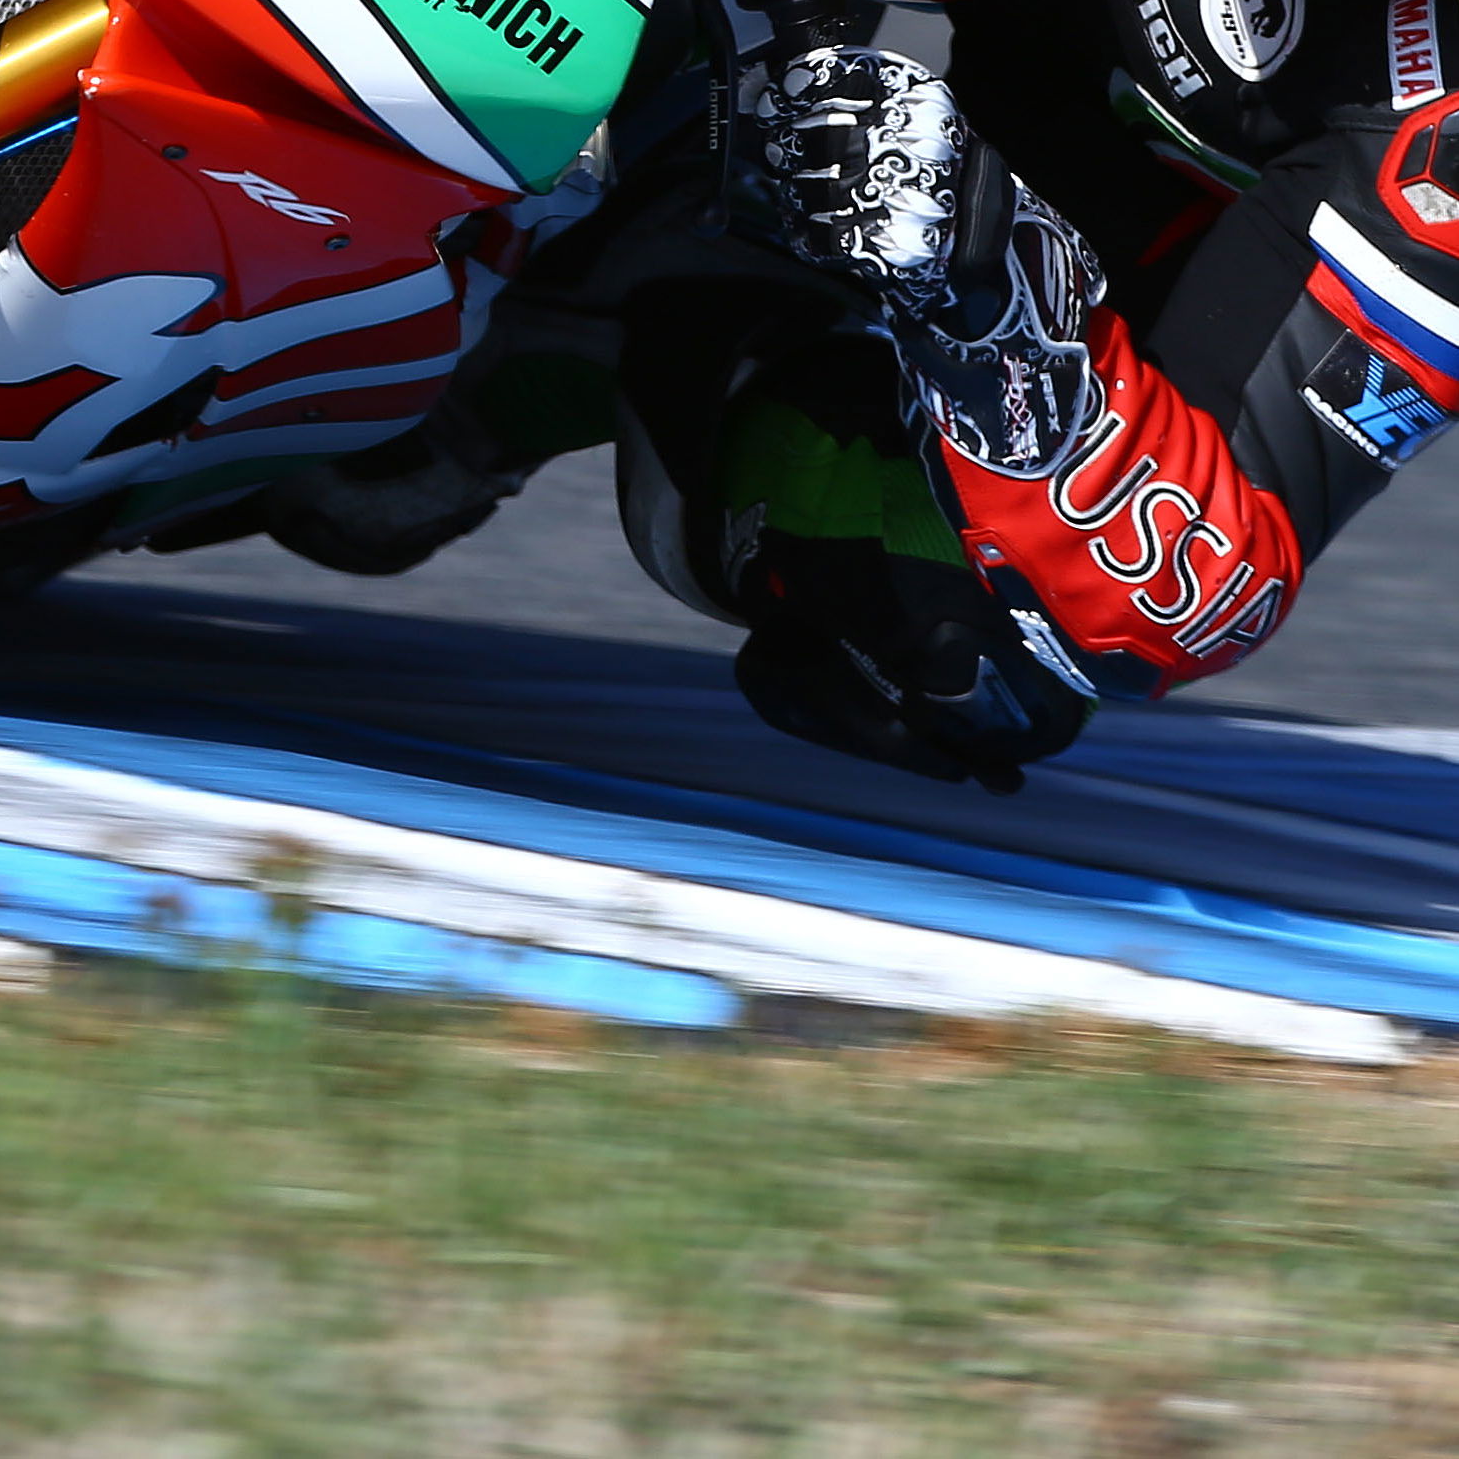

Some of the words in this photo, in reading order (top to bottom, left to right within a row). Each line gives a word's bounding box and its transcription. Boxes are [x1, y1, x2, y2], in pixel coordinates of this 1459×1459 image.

[709, 78, 730, 151] domino
[197, 167, 352, 227] R6
[1049, 373, 1285, 660] USSIA
